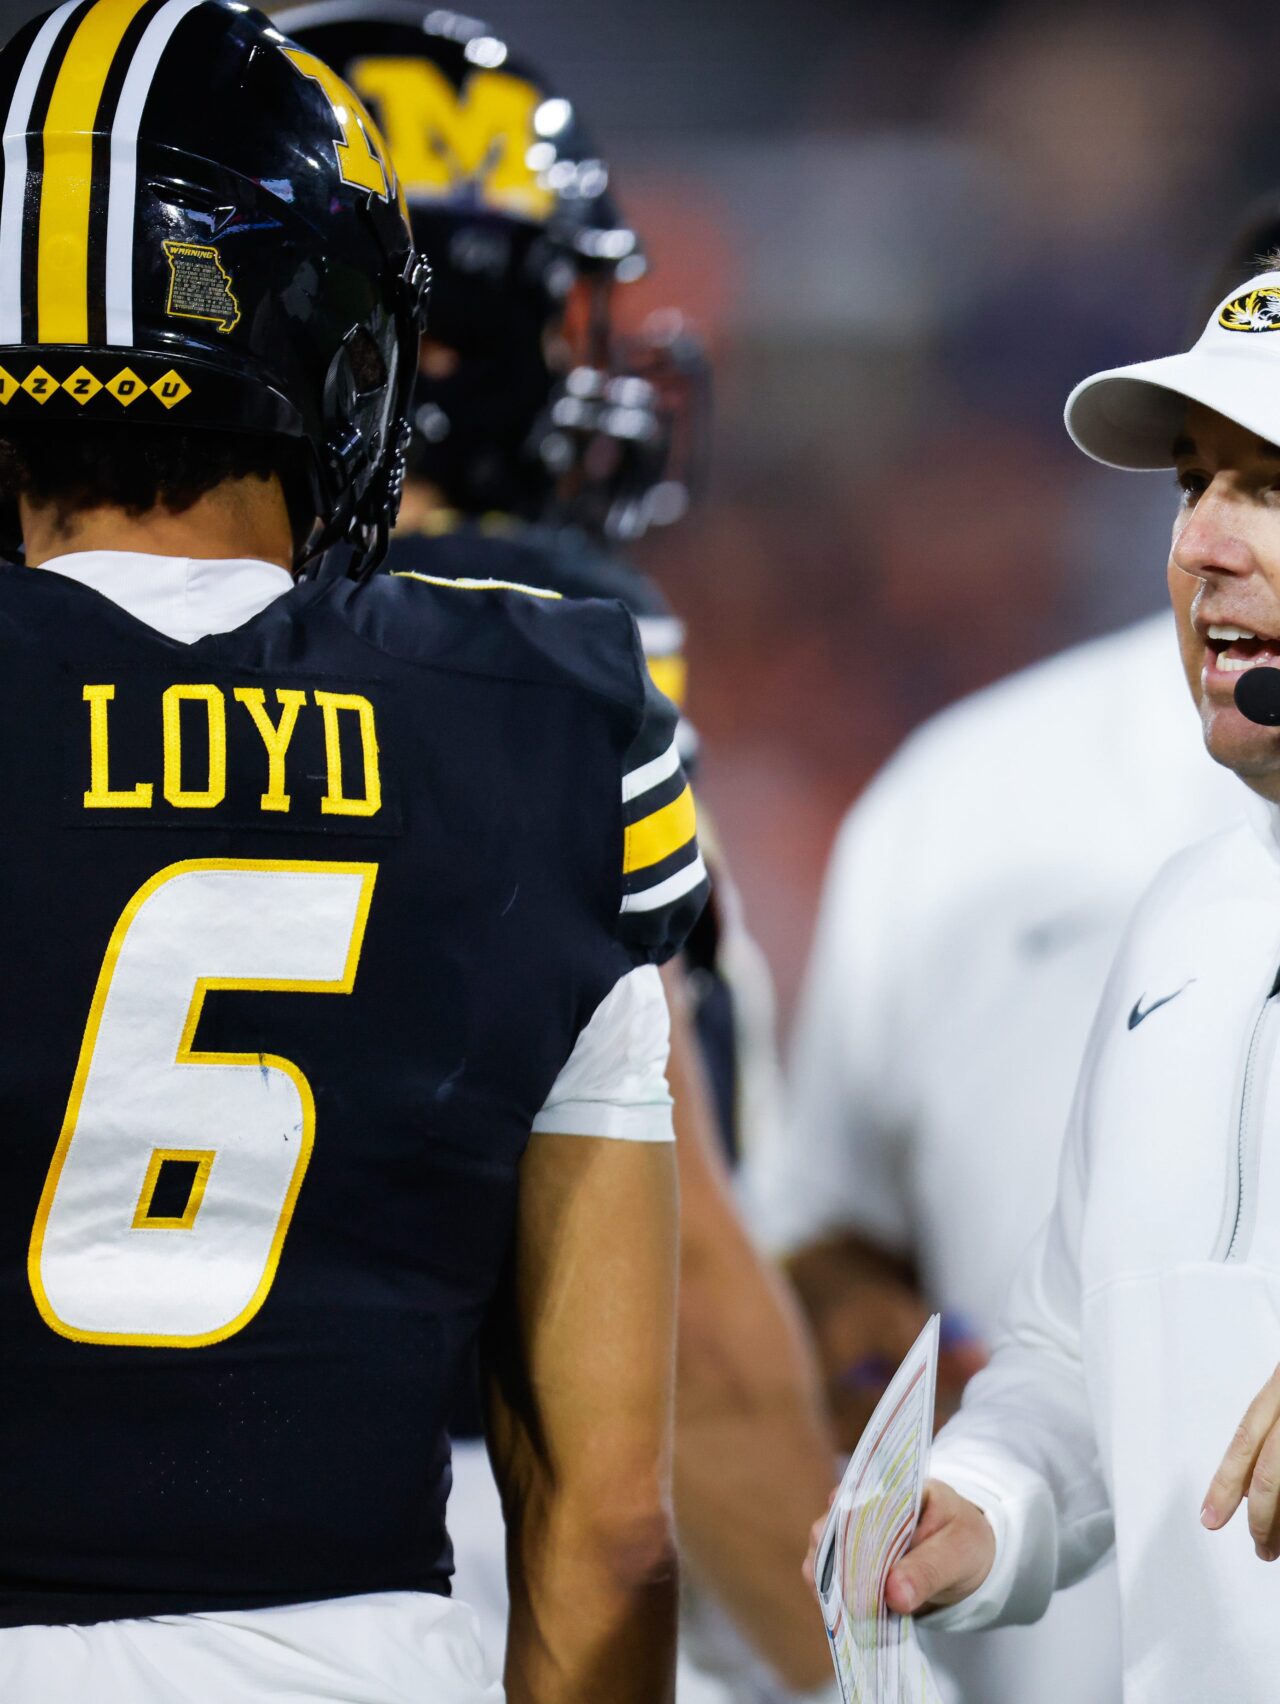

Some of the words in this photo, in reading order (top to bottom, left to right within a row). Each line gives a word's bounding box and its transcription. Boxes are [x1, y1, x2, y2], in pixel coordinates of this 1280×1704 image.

[351, 56, 555, 222] M
[169, 246, 215, 260] WARNING
[82, 684, 382, 816] LOYD
[27, 857, 379, 1348] 6
